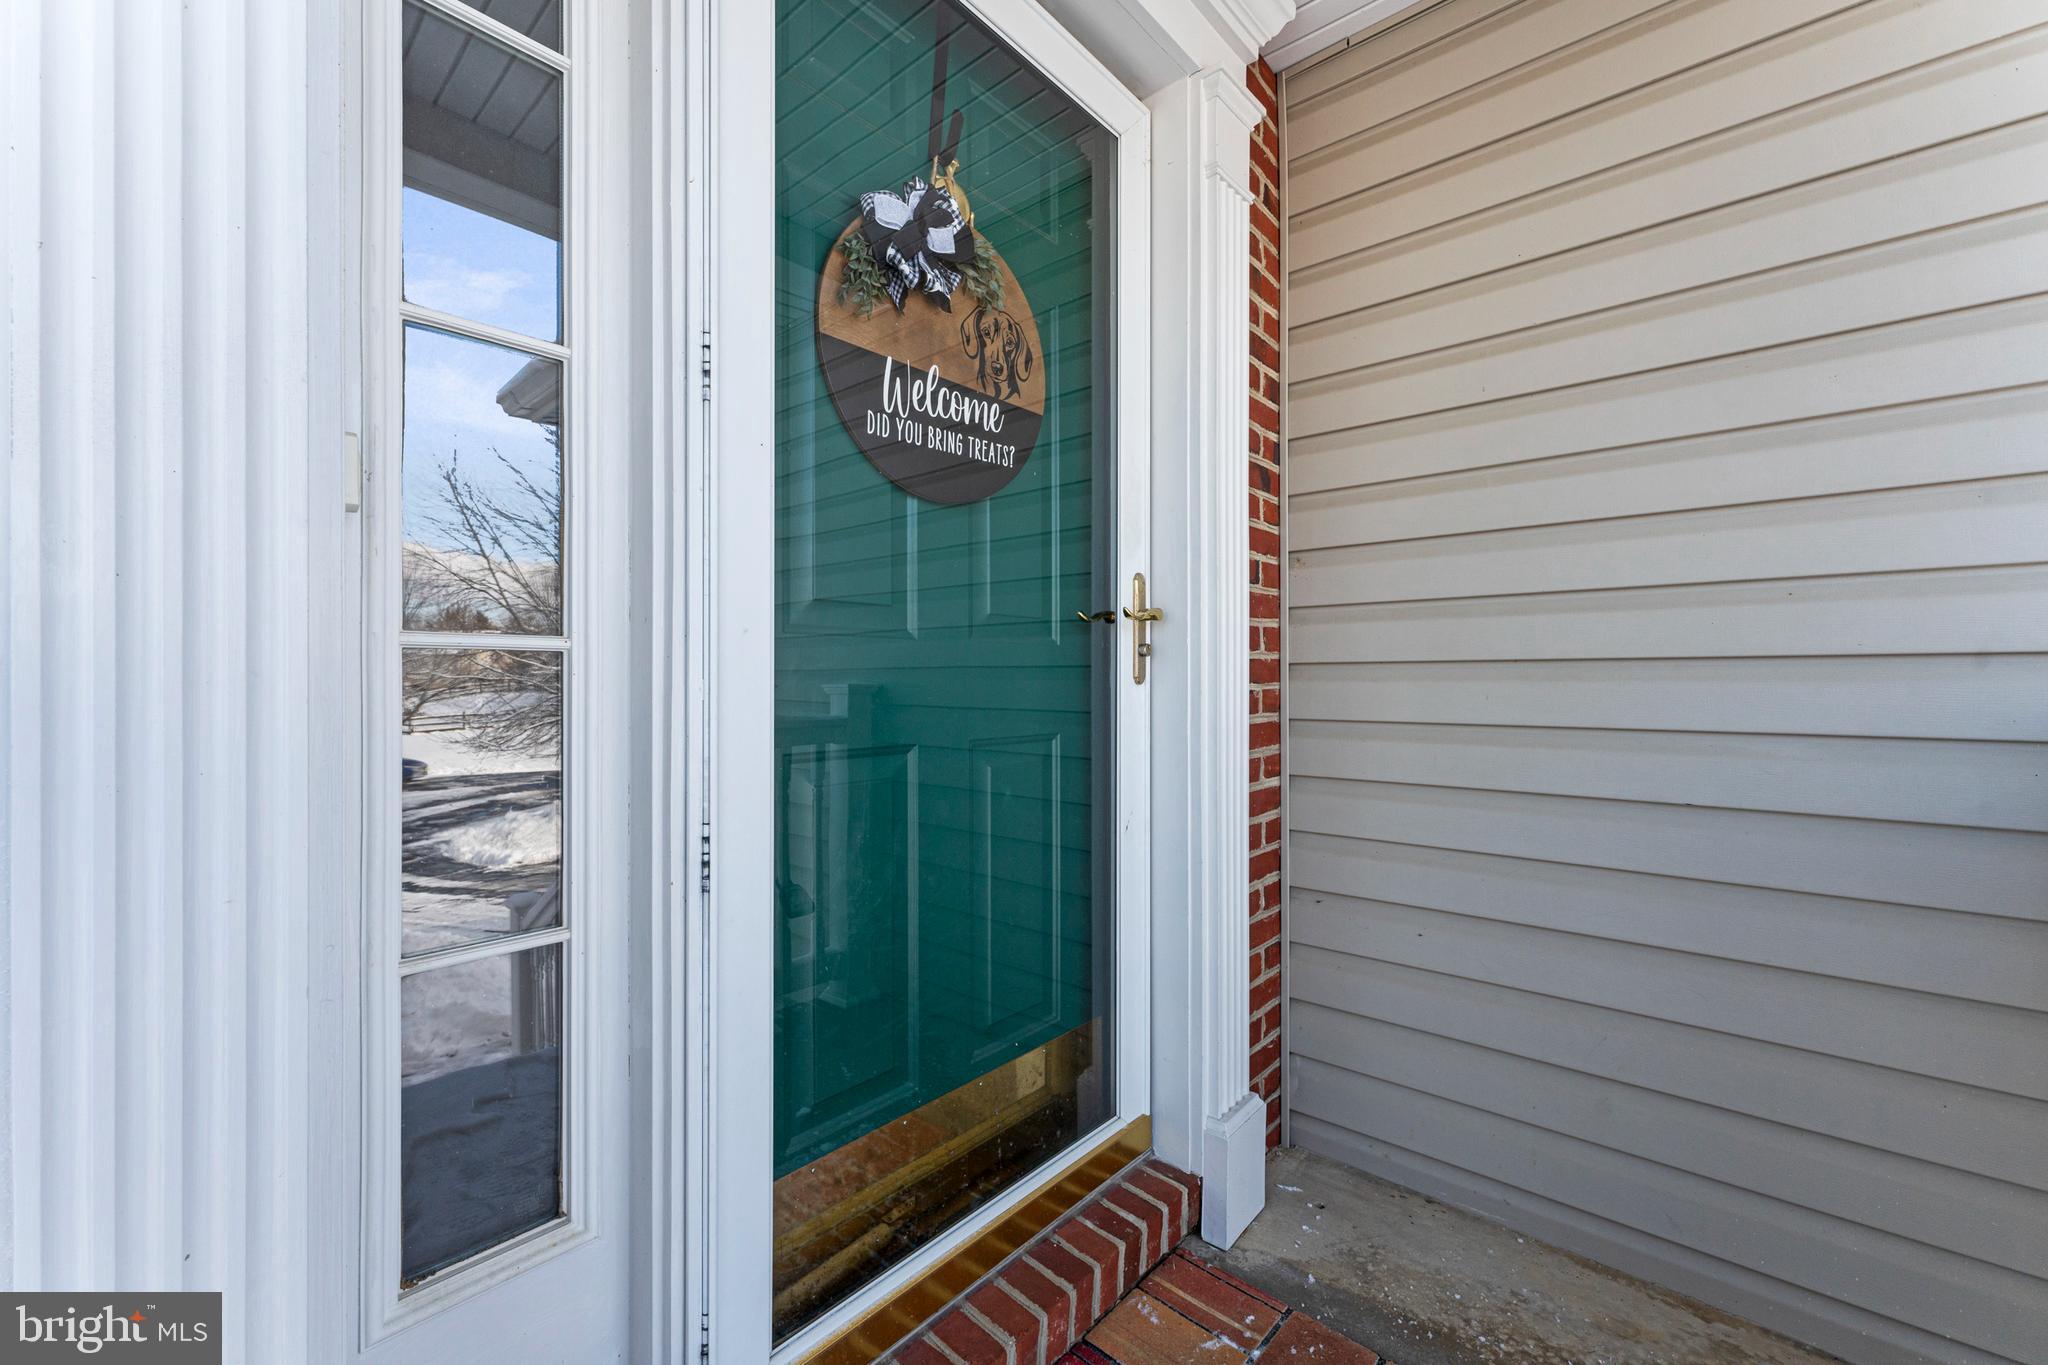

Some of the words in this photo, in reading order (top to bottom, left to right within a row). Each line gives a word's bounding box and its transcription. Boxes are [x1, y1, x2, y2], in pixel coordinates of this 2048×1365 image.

[882, 355, 1005, 433] Welcome
[866, 409, 890, 438] DID
[895, 417, 923, 446] YOU
[927, 425, 963, 456] BRING
[967, 435, 1016, 468] TREATS?
